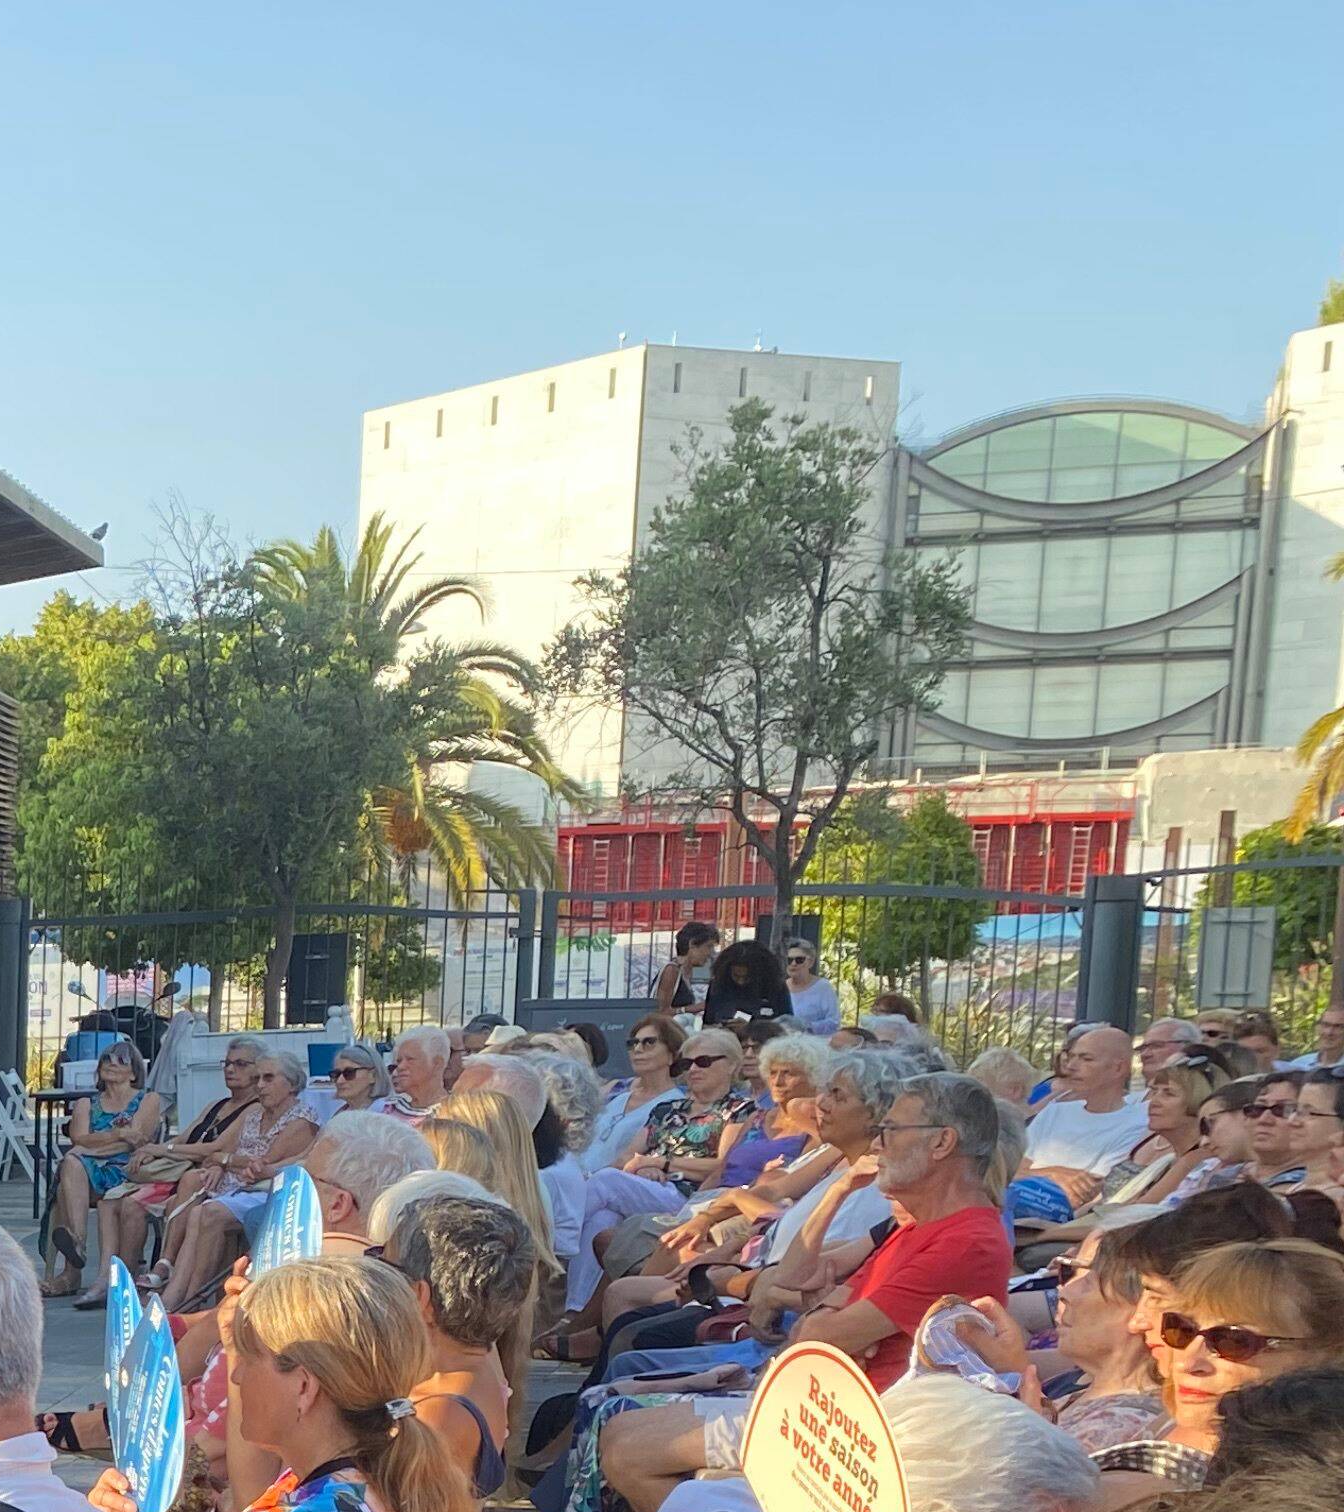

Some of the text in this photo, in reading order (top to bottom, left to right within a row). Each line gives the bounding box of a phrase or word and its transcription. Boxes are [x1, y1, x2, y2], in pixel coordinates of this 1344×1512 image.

[780, 1408, 790, 1441] à
[793, 1429, 831, 1483] votre
[799, 1402, 827, 1441] une
[828, 1435, 880, 1499] saison
[809, 1373, 878, 1462] Rajoutez
